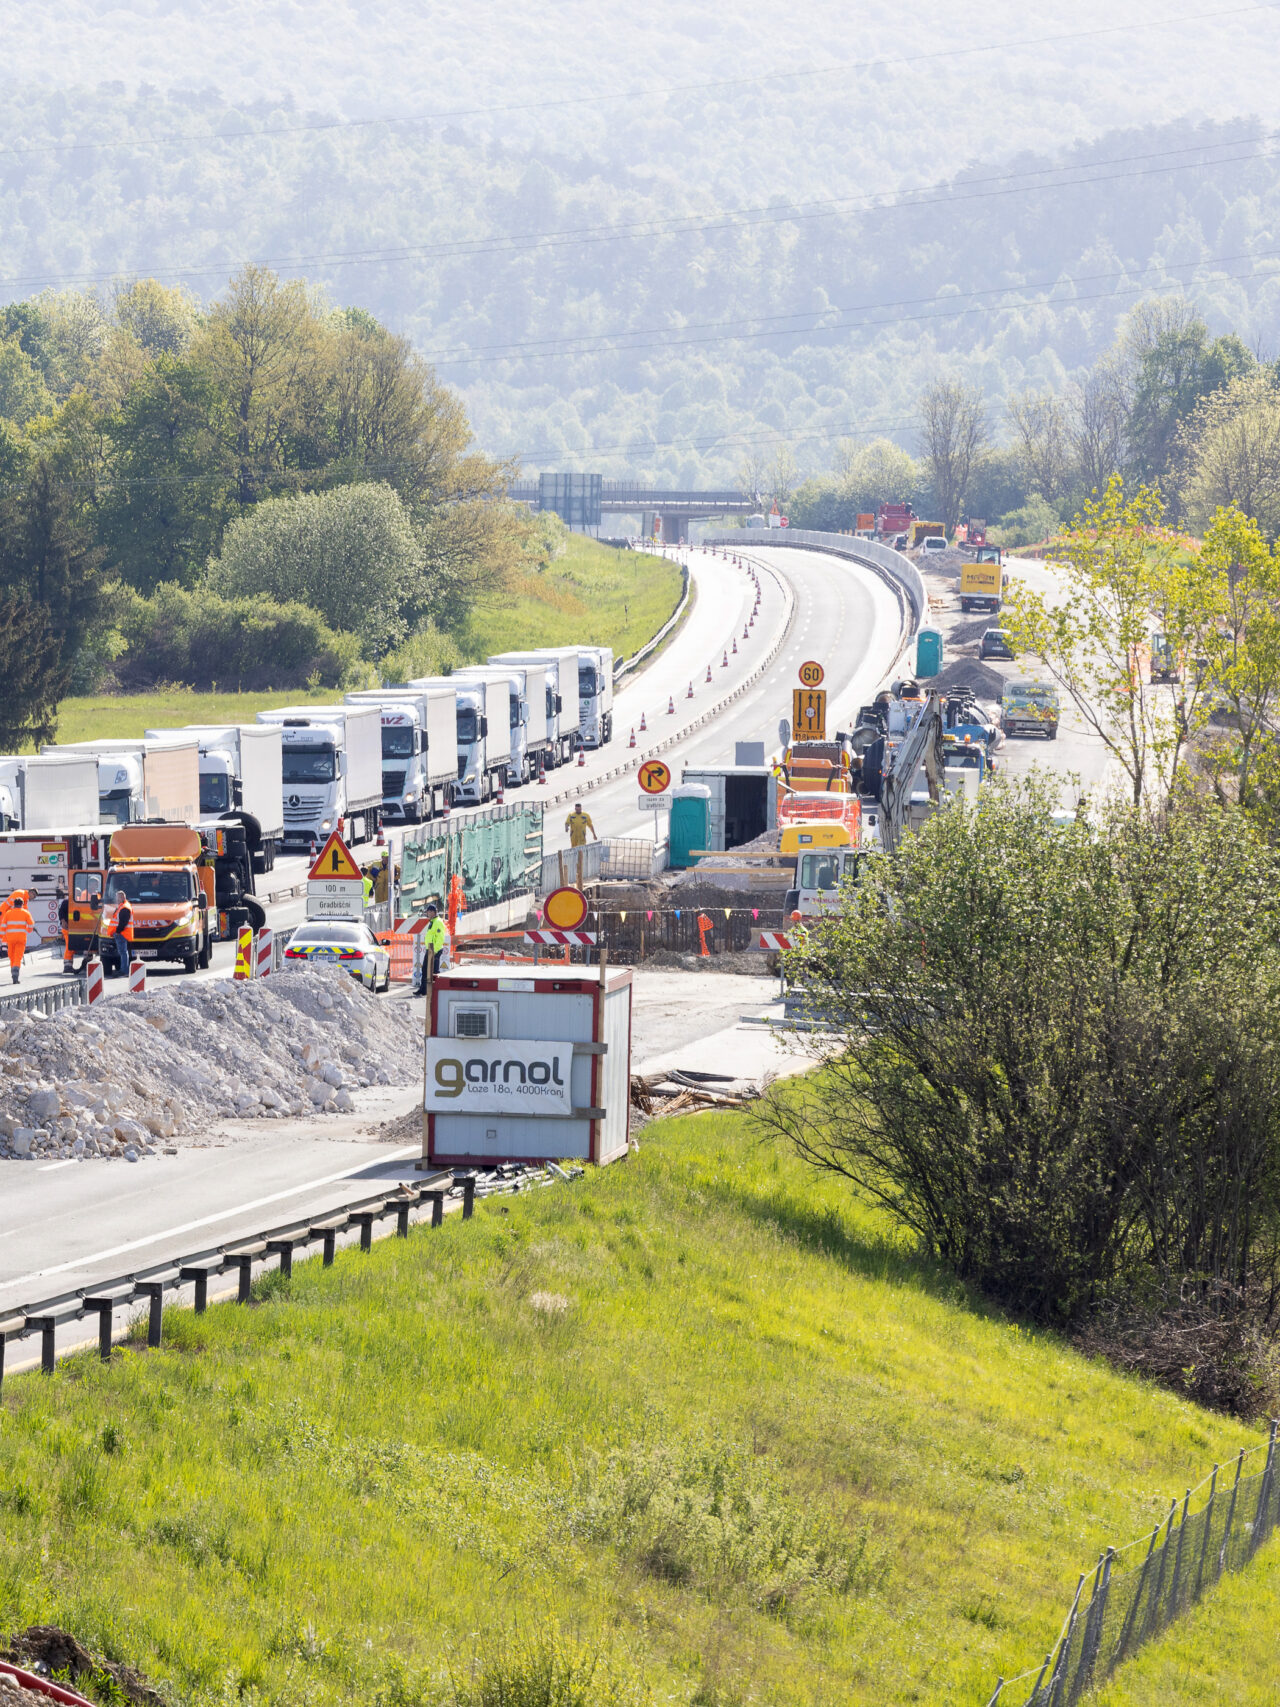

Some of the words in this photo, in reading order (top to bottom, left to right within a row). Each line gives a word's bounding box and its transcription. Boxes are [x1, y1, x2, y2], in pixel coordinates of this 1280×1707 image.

[803, 667, 820, 681] 60
[325, 884, 337, 893] 100
[434, 1056, 564, 1098] garnol
